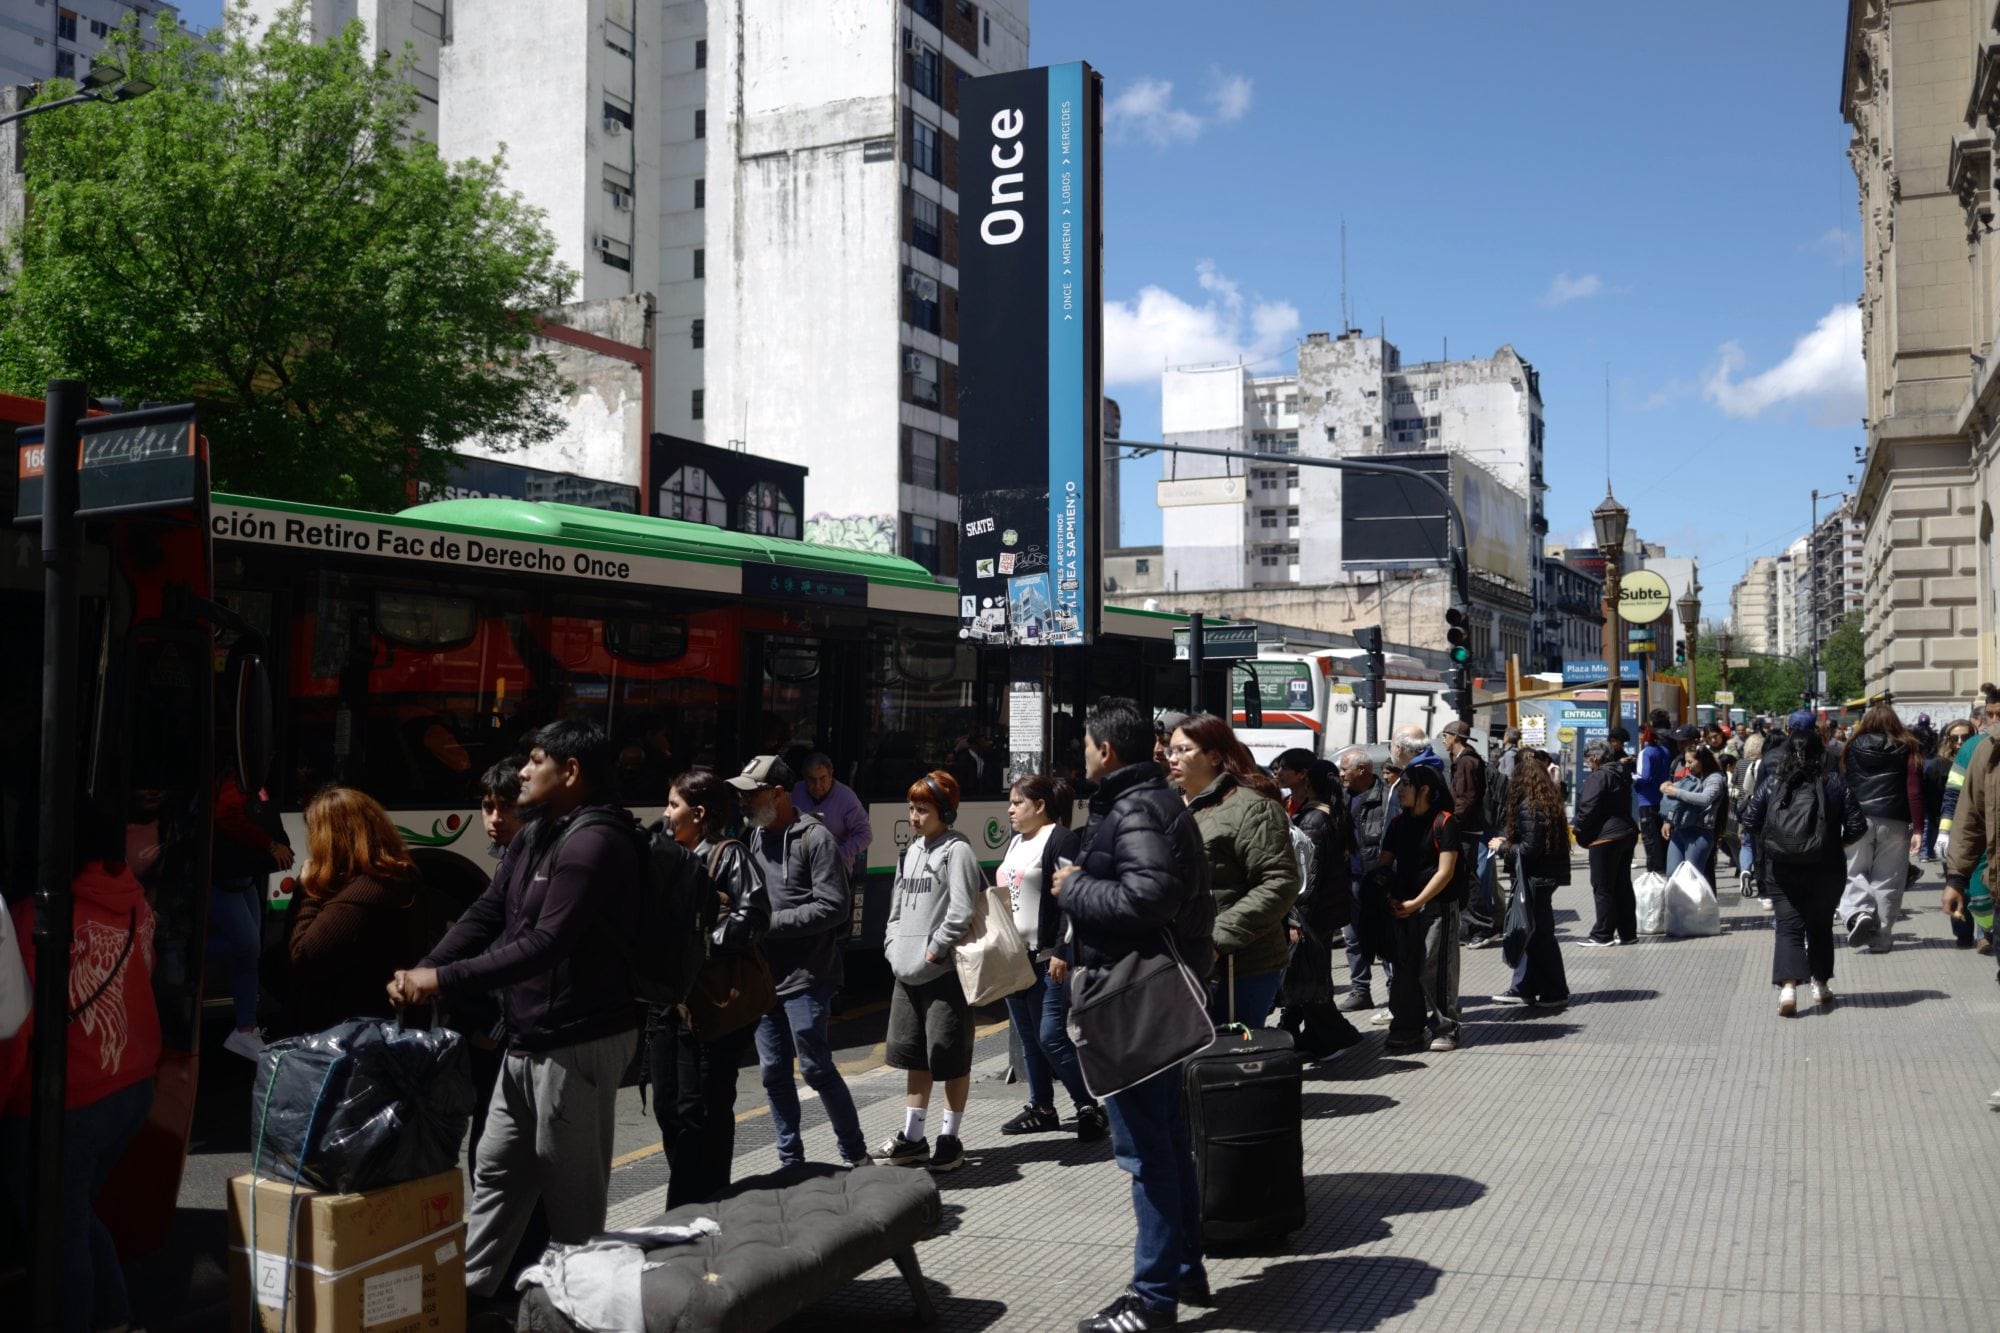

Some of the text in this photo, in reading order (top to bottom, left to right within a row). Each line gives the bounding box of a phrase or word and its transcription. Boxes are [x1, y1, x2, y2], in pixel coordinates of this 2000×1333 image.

[980, 107, 1024, 246] Once
[1062, 100, 1072, 310] ONCE MORENO LOBOS MERCEDES
[966, 517, 995, 537] SKATE!
[211, 511, 630, 580] ción Retiro Fac de Derecho Once
[1619, 587, 1664, 601] Subte
[1567, 664, 1590, 673] Plaza
[1335, 703, 1348, 713] 110
[1564, 710, 1602, 718] ENTRADA
